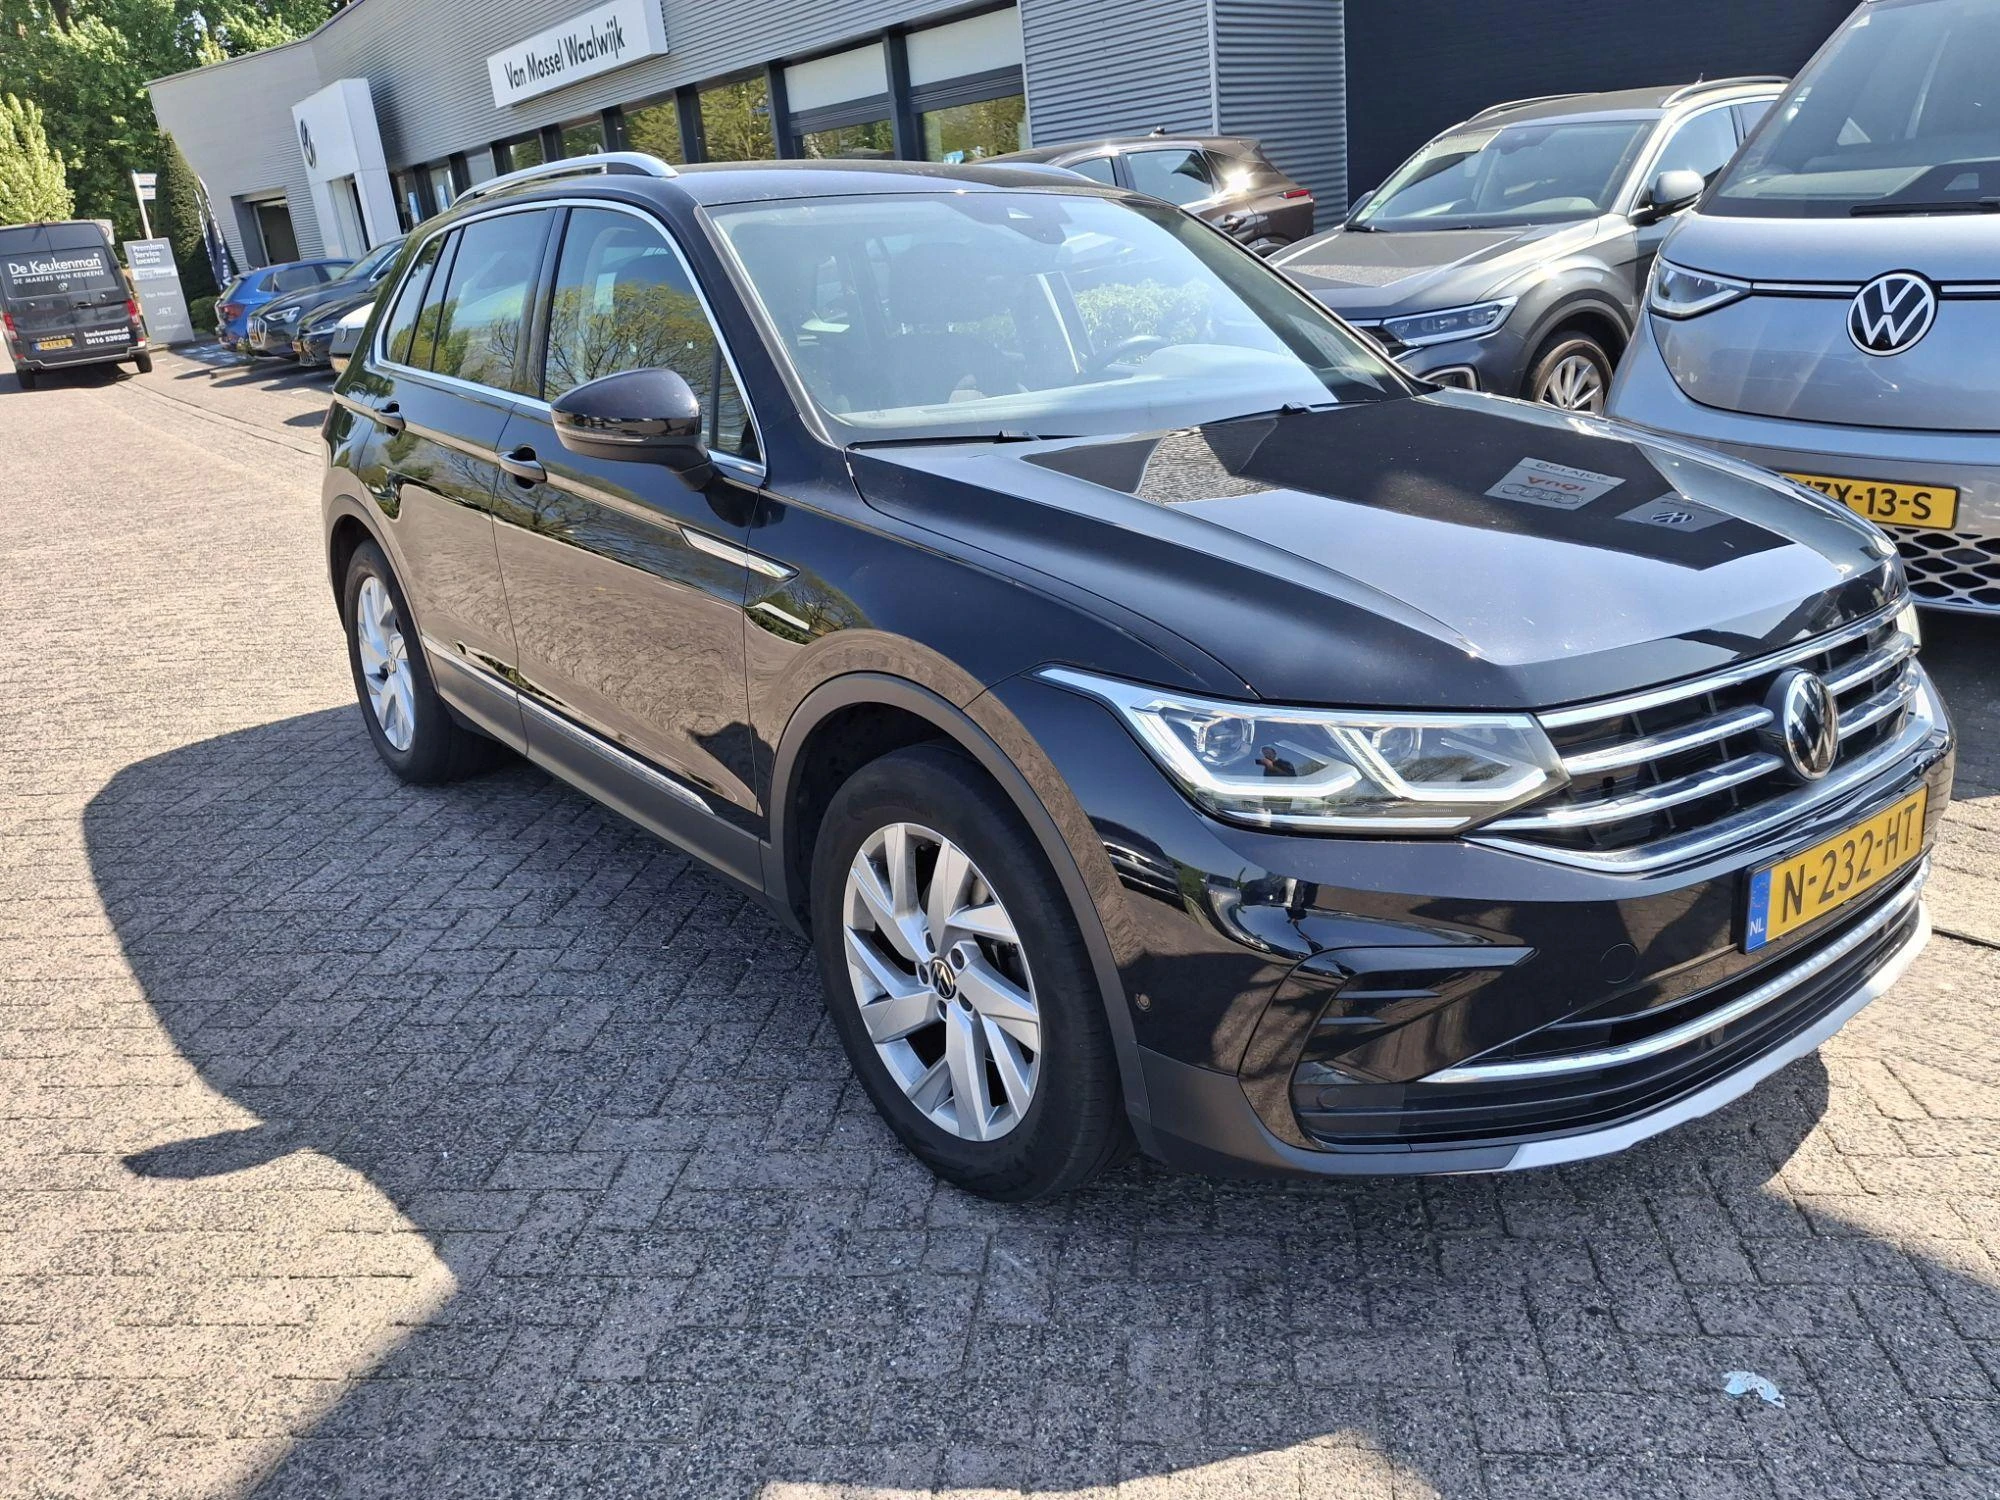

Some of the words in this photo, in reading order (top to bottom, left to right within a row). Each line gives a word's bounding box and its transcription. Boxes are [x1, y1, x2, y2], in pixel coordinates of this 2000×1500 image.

[504, 61, 527, 90] Van
[526, 39, 565, 82] Mossel
[563, 15, 626, 67] Waalwijk
[134, 251, 160, 259] Service
[8, 262, 28, 275] De
[29, 256, 102, 274] Keukenman
[25, 275, 54, 284] MAKERS
[73, 270, 105, 279] KEUKENS
[86, 337, 104, 345] 0416
[1781, 802, 1918, 923] N-232-HT
[1749, 917, 1765, 938] NL
